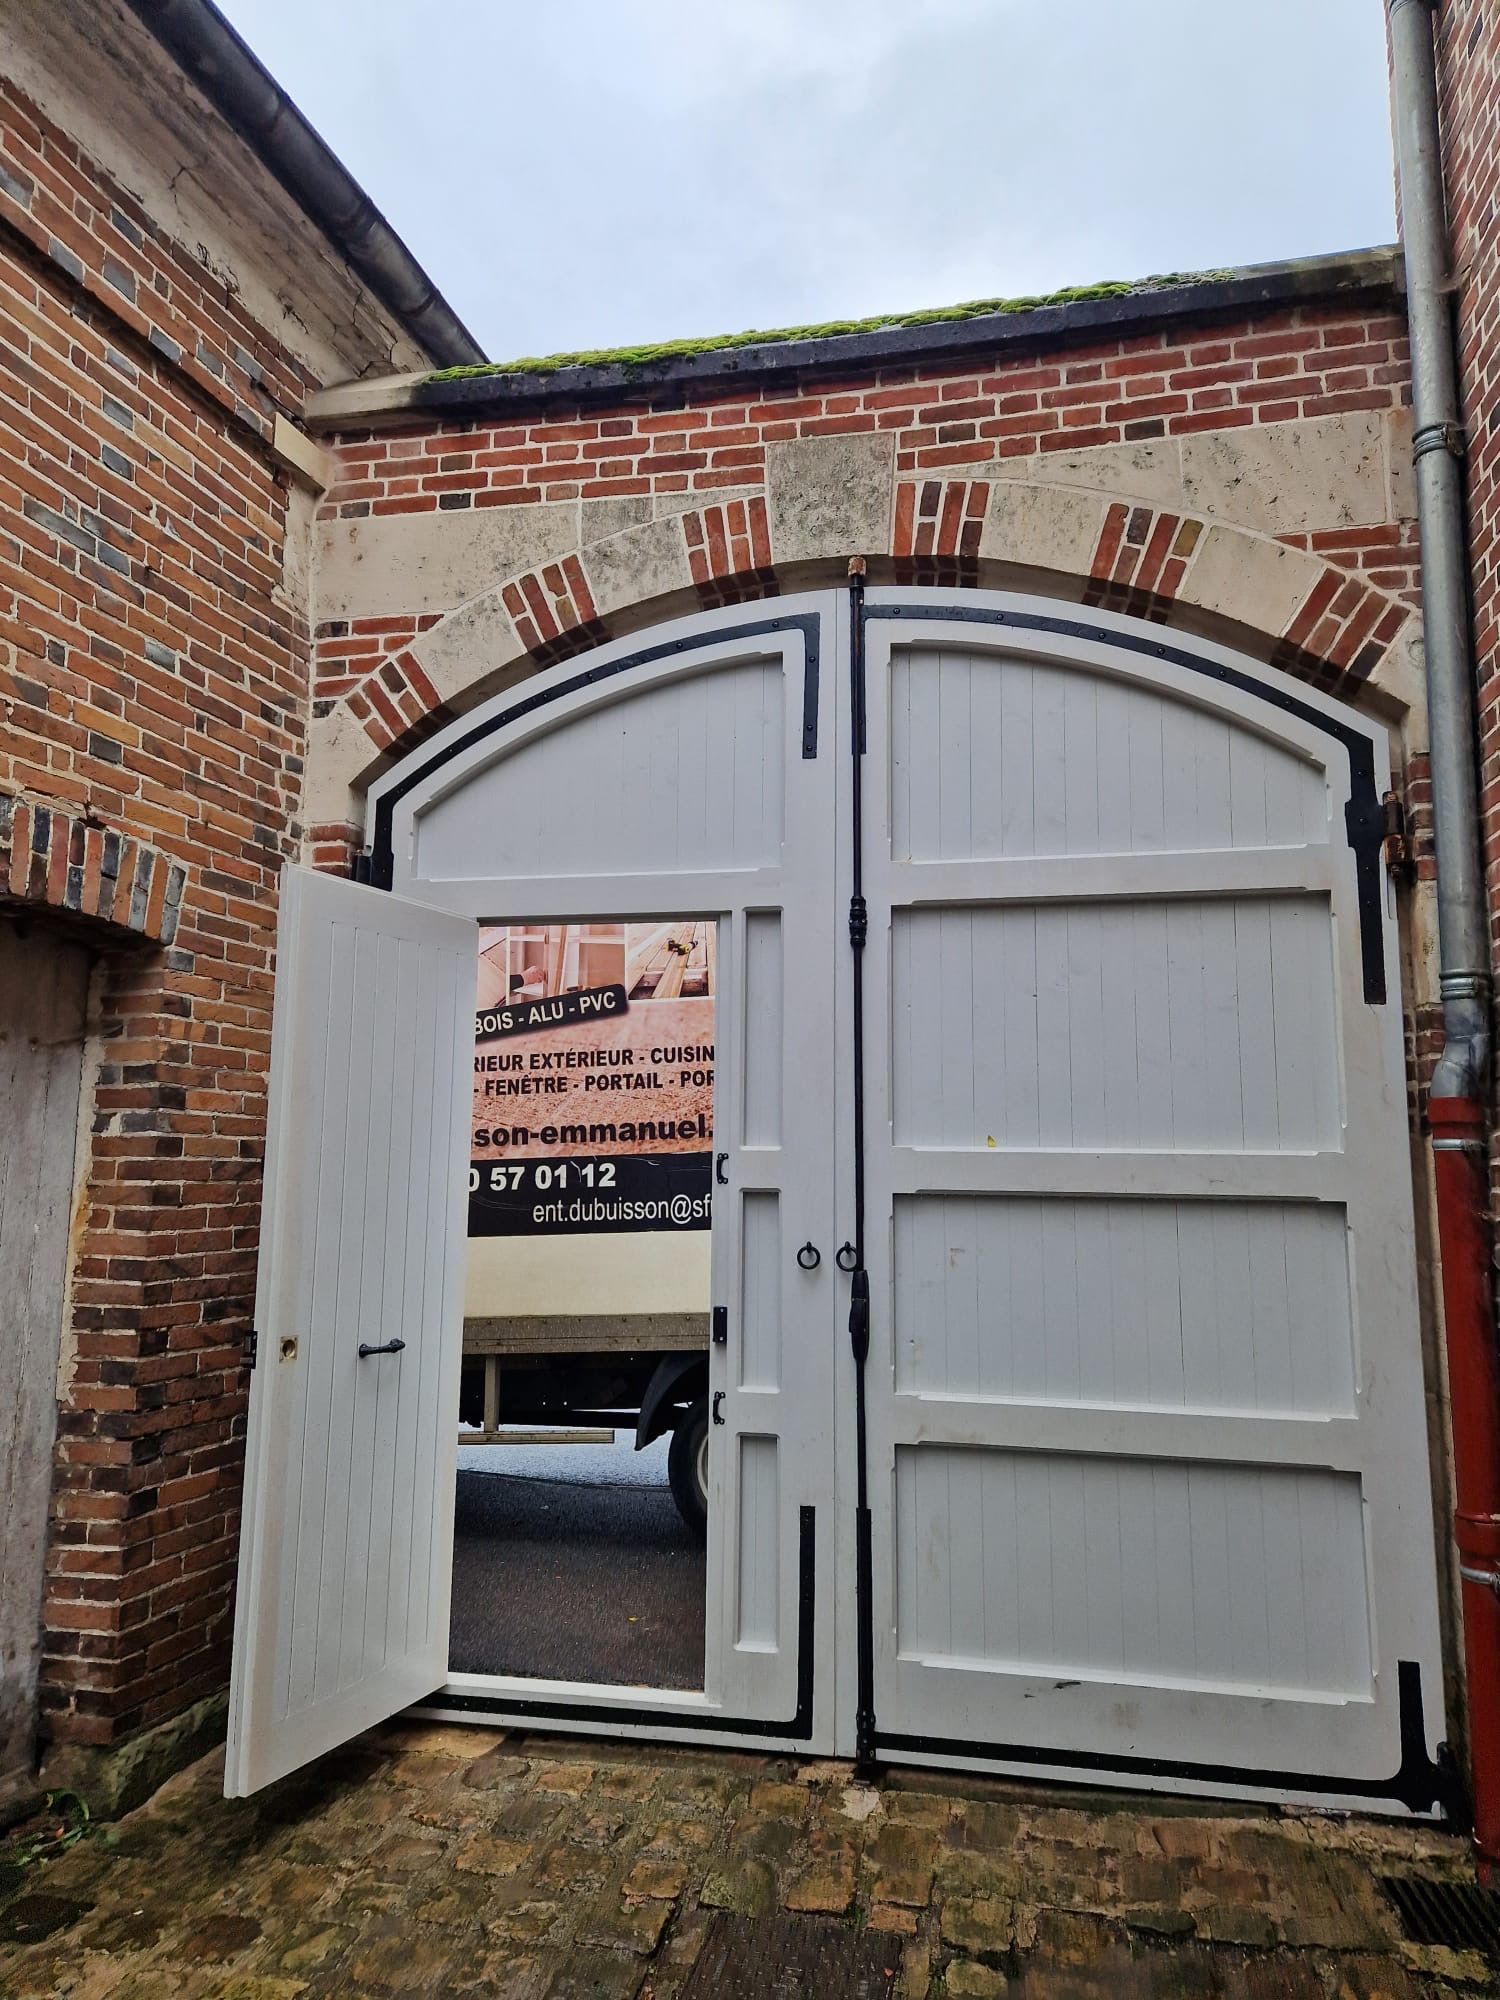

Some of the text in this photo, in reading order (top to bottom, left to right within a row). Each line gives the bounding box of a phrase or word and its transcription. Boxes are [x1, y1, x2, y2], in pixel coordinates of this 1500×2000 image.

[475, 1011, 514, 1035] BOIS
[528, 1004, 564, 1025] ALU
[579, 991, 617, 1014] PVC
[529, 1048, 634, 1069] EXTÉRIEUR
[650, 1045, 715, 1064] CUISIN
[485, 1074, 568, 1096] FENÊTRE
[584, 1073, 663, 1091] PORTAIL
[680, 1069, 715, 1088] POR
[489, 1166, 526, 1191] 57
[534, 1163, 568, 1189] 01
[580, 1162, 617, 1188] 12
[532, 1193, 713, 1225] ent.dubuisson@sf
